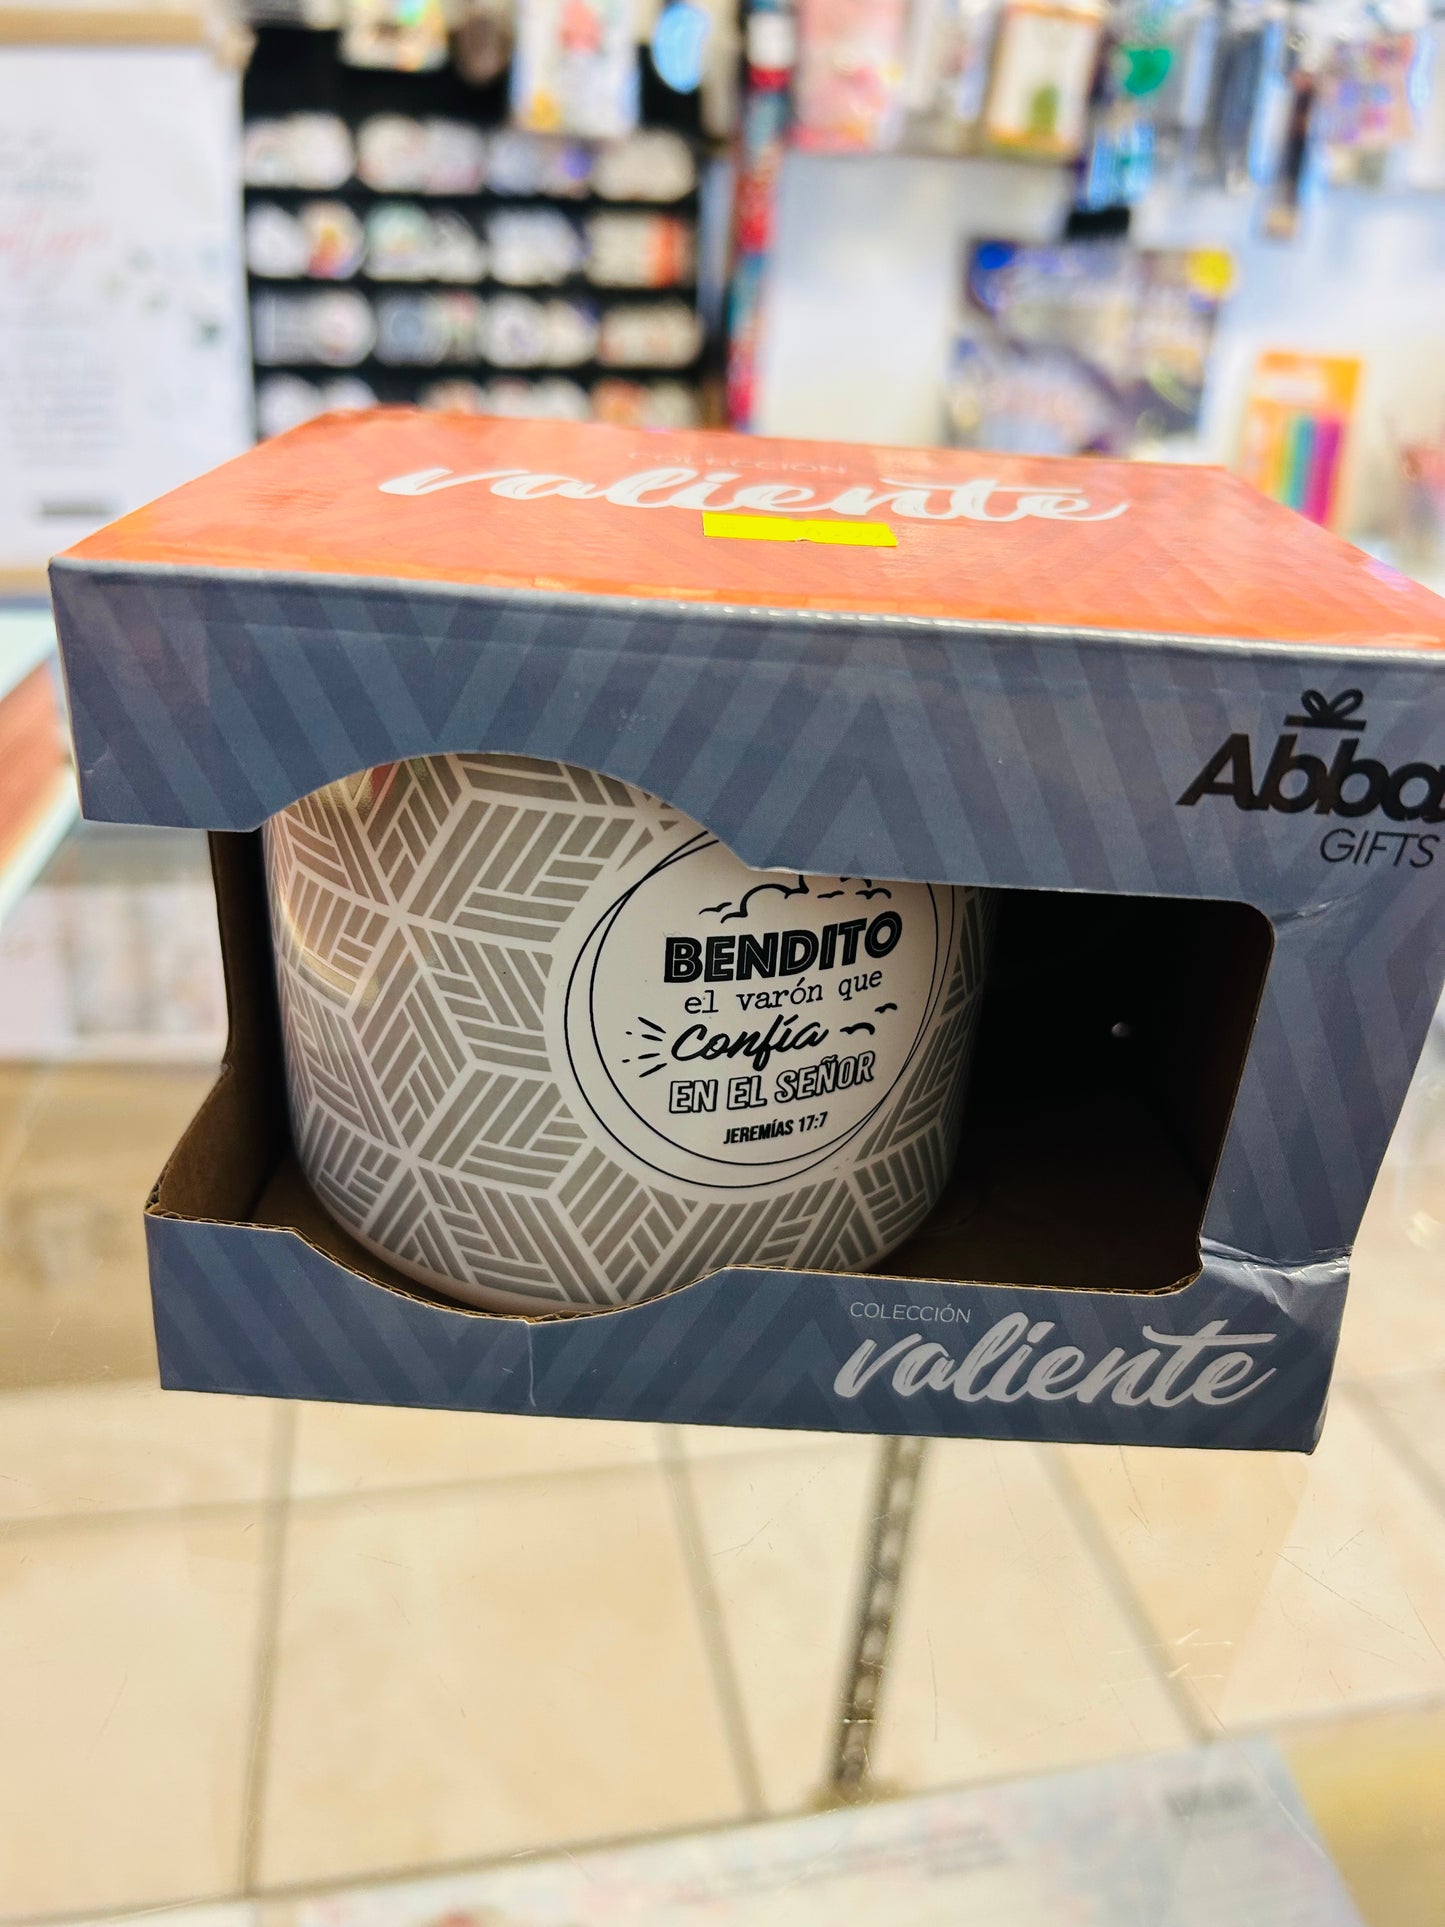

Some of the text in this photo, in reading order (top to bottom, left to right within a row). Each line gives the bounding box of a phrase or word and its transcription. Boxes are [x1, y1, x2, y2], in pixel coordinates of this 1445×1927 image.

[379, 467, 1130, 522] valiente
[1320, 827, 1440, 868] GIFTS
[664, 911, 903, 983] BENDITO
[684, 970, 883, 1014] el varón que
[671, 1014, 829, 1071] Confía
[669, 1050, 876, 1114] EN EL SEÑOR
[723, 1111, 828, 1144] JEREMÍAS 17:7
[849, 1301, 972, 1324] COLECCIÓN
[833, 1311, 1277, 1408] valiente
